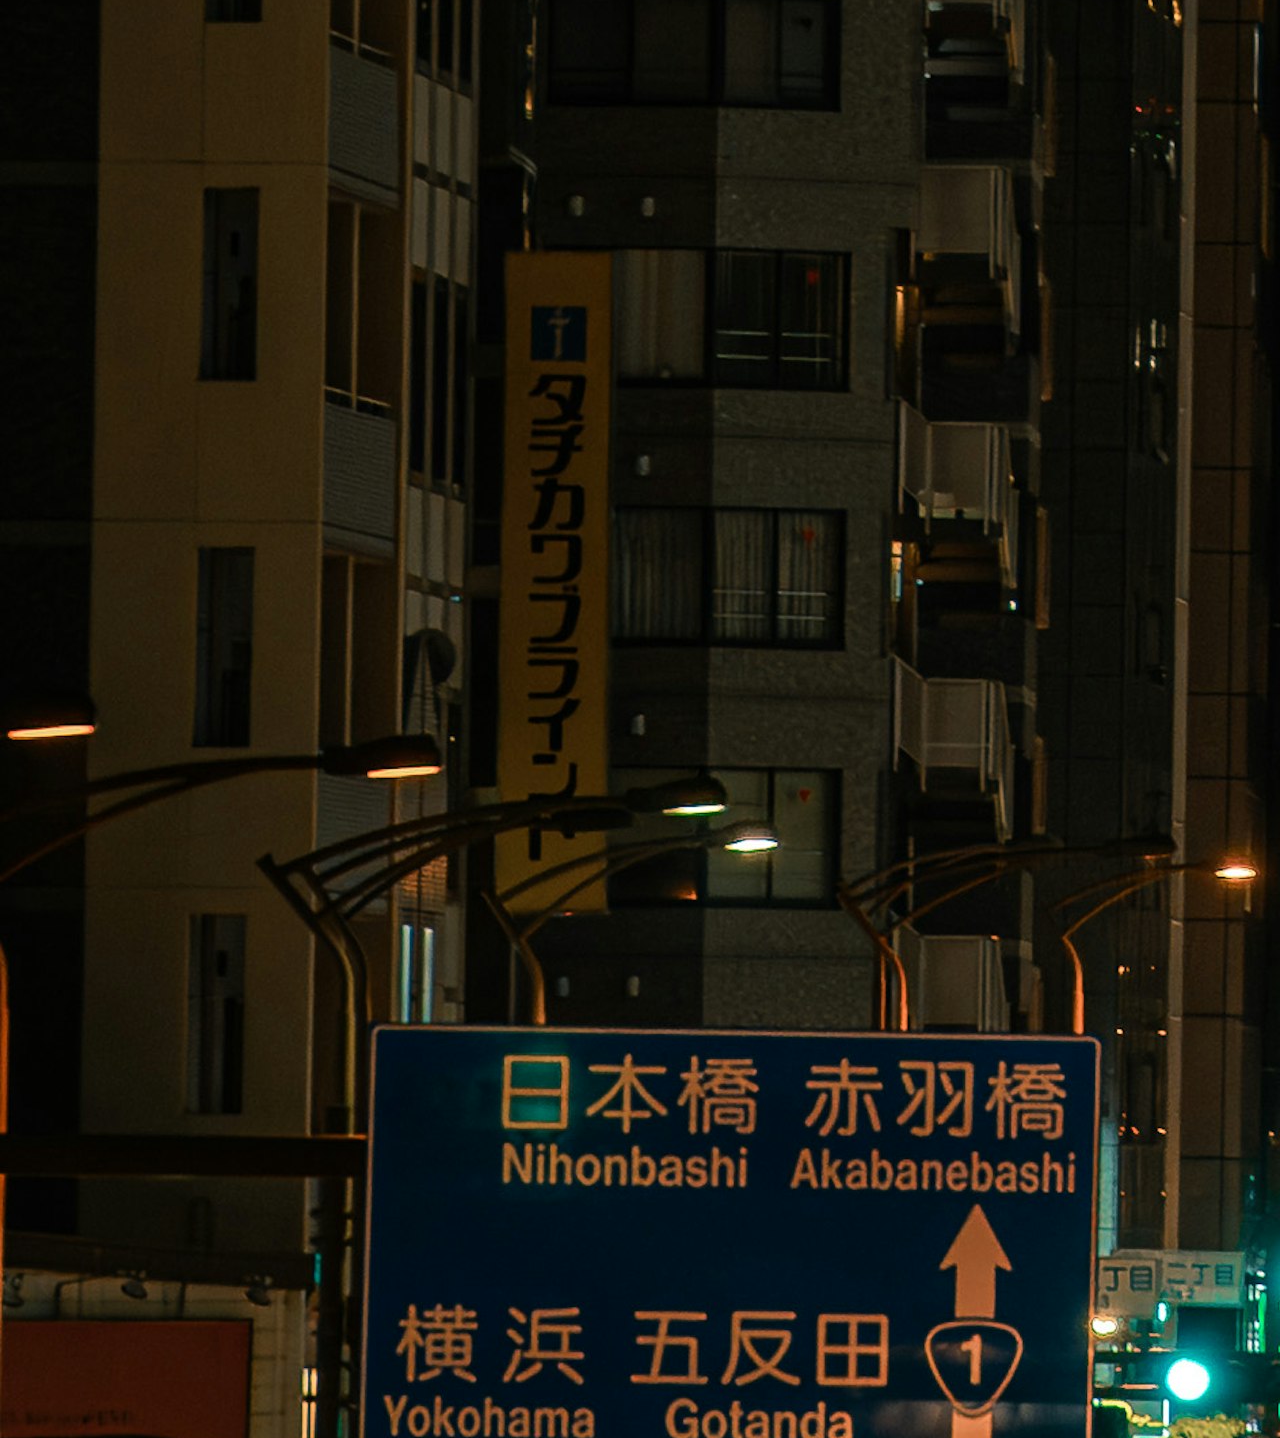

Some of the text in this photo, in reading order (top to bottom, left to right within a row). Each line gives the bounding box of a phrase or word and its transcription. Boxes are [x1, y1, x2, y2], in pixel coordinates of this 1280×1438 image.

[501, 1053, 1068, 1140] 日本橋 赤羽橋
[501, 1143, 1077, 1193] Nihonbashi Akabanebashi
[396, 1303, 983, 1388] 横浜 五反田 1
